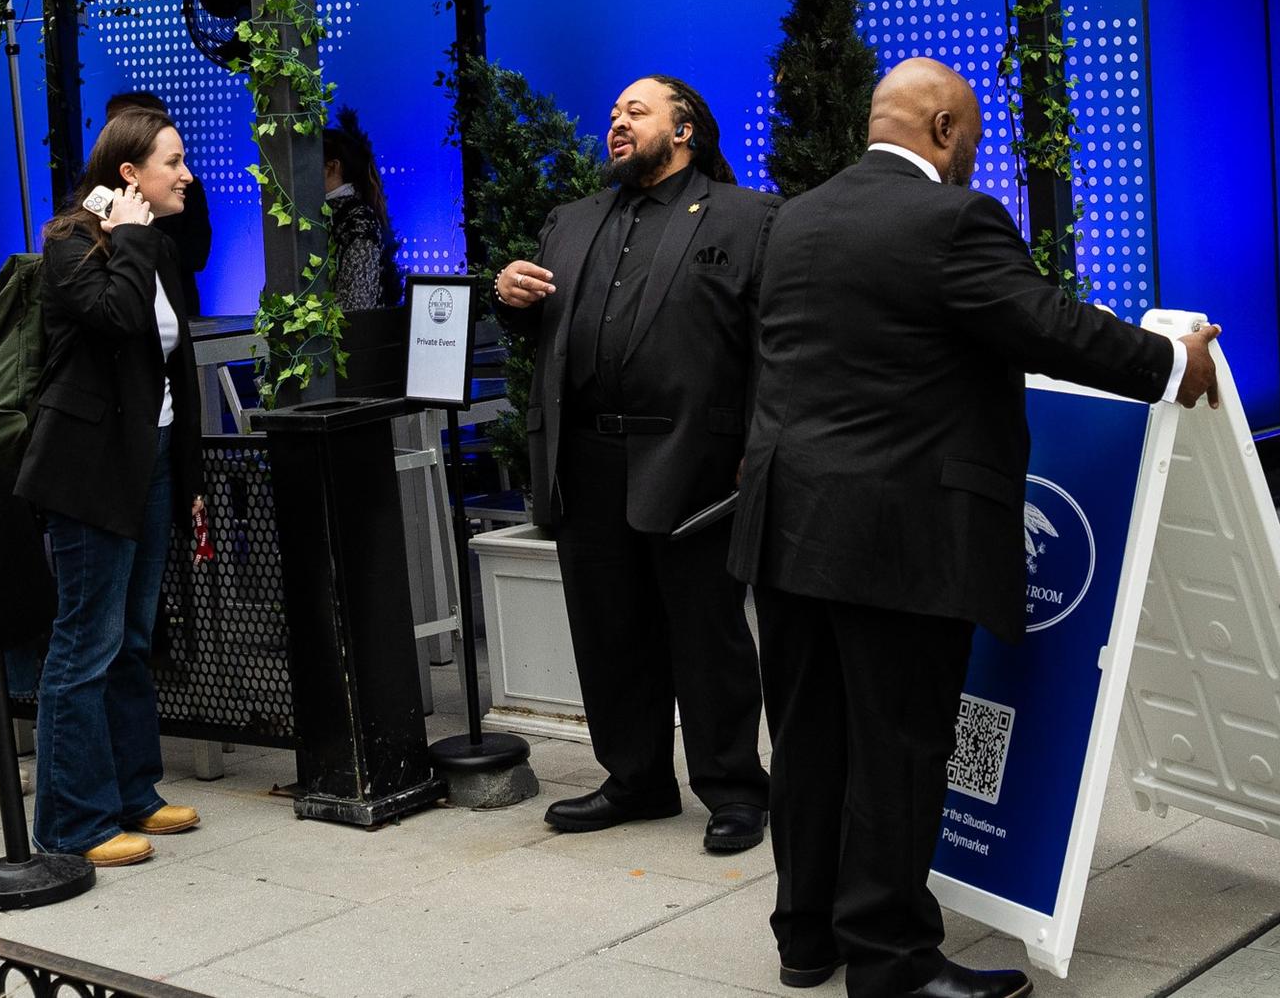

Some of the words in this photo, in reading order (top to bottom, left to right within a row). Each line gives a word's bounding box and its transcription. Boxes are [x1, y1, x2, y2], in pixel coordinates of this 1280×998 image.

[416, 337, 438, 347] Private
[438, 338, 456, 347] Event
[1030, 585, 1063, 604] ROOM
[949, 809, 962, 822] the
[962, 813, 996, 835] Situation
[996, 827, 1007, 839] on
[942, 827, 989, 856] Polymarket
